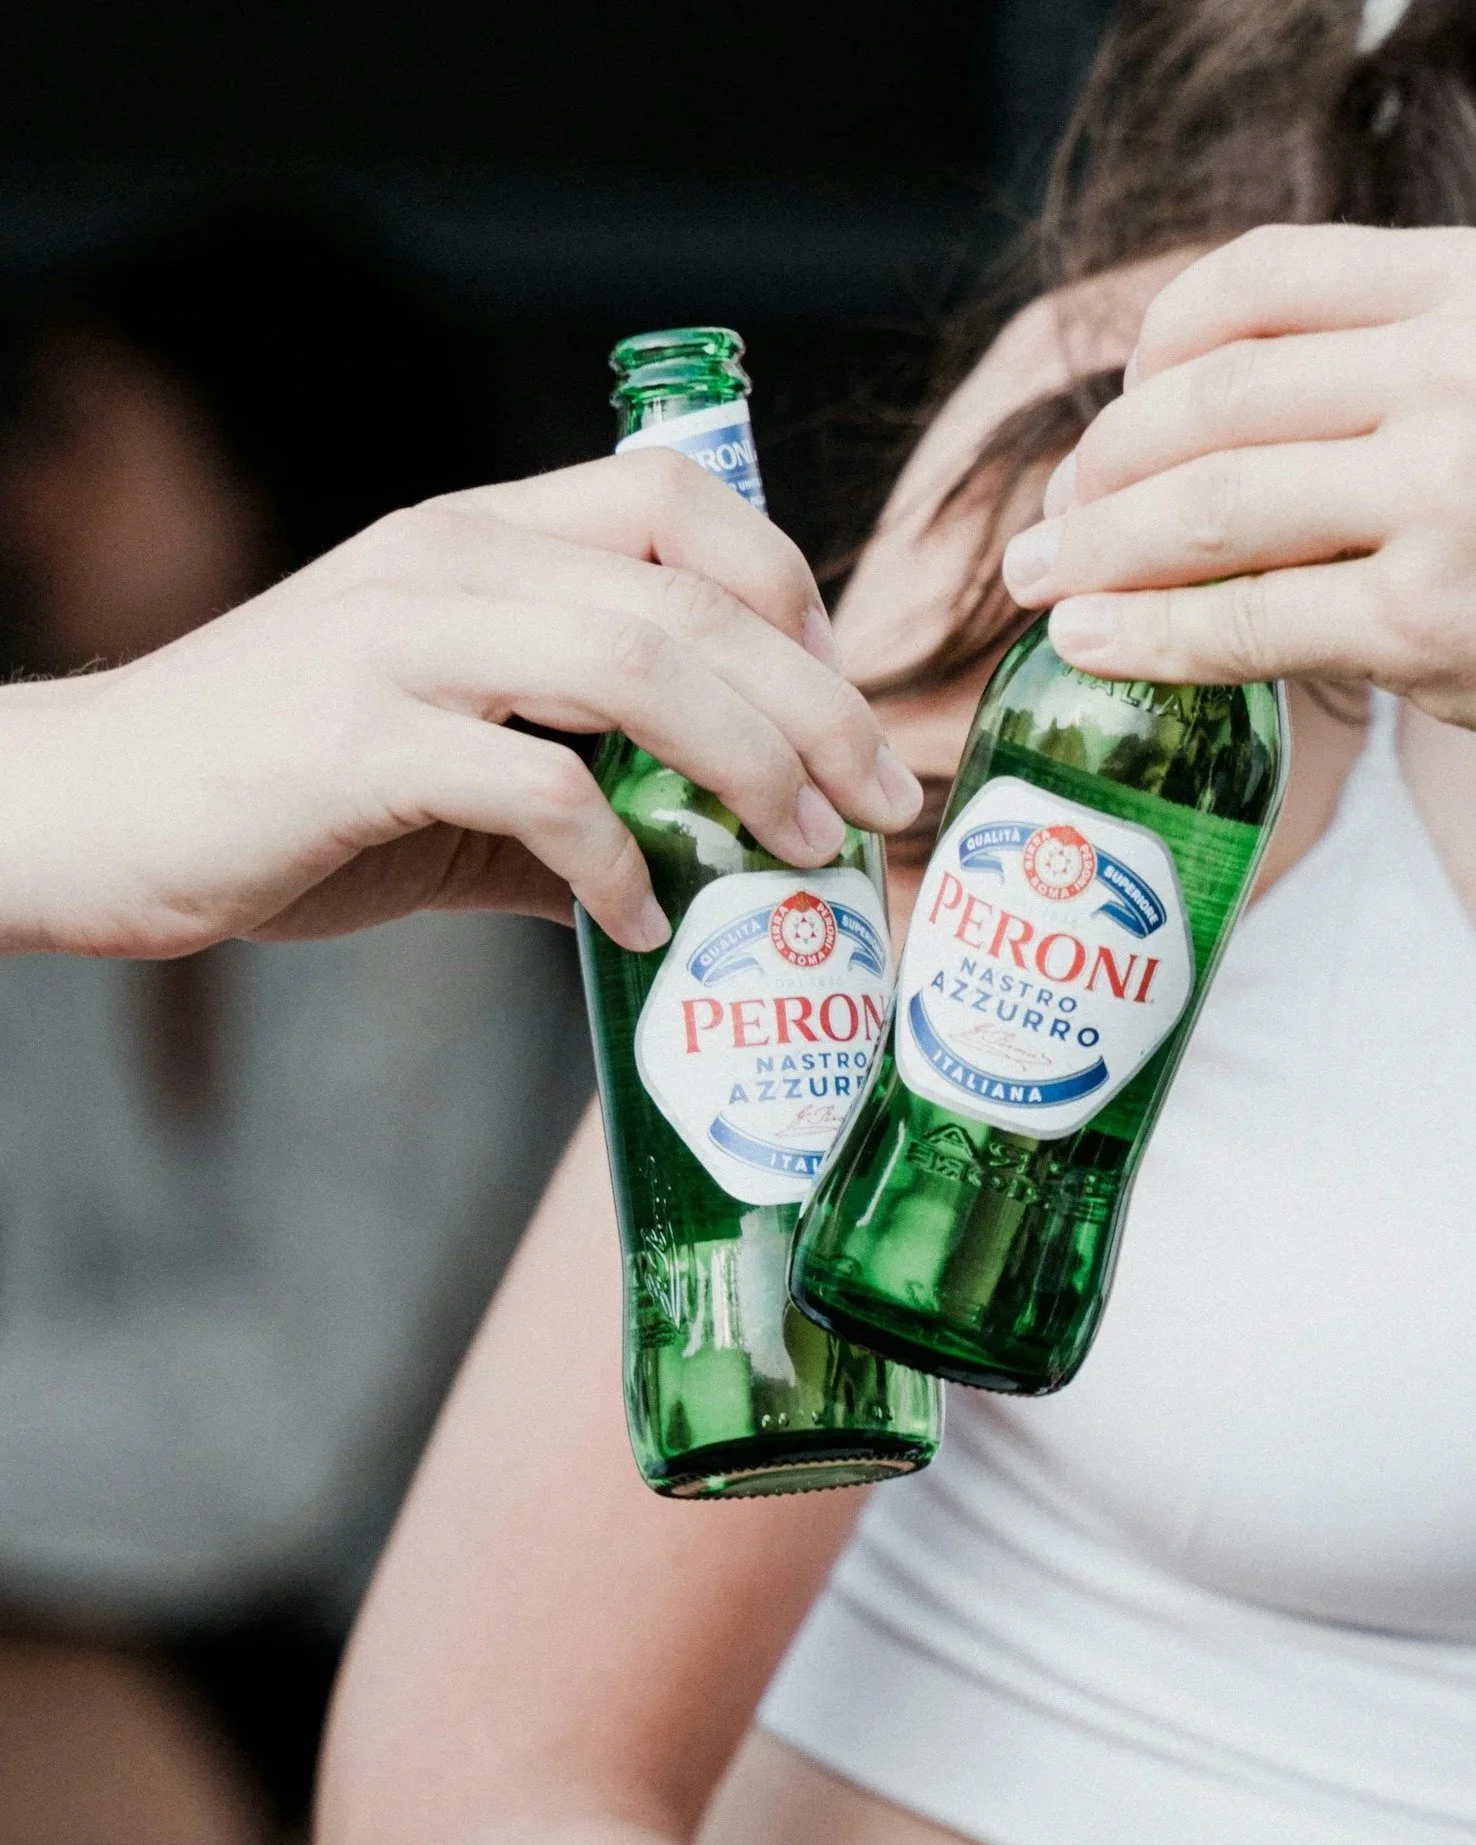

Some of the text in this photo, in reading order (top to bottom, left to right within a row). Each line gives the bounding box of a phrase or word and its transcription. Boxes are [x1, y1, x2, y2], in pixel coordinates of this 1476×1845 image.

[689, 440, 757, 472] RON
[1103, 864, 1159, 926] SUPERIORE
[816, 901, 836, 950] PERONI
[928, 871, 1160, 1004] PERONI
[788, 950, 826, 967] ROMA
[931, 971, 1100, 1048] AZZURRO
[961, 957, 1079, 1013] NASTRO
[681, 993, 885, 1054] PERON
[756, 1052, 867, 1073] NASTRO
[932, 1050, 1043, 1103] ITALIANA
[729, 1075, 866, 1105] AZZUR
[770, 1152, 822, 1174] ITAL
